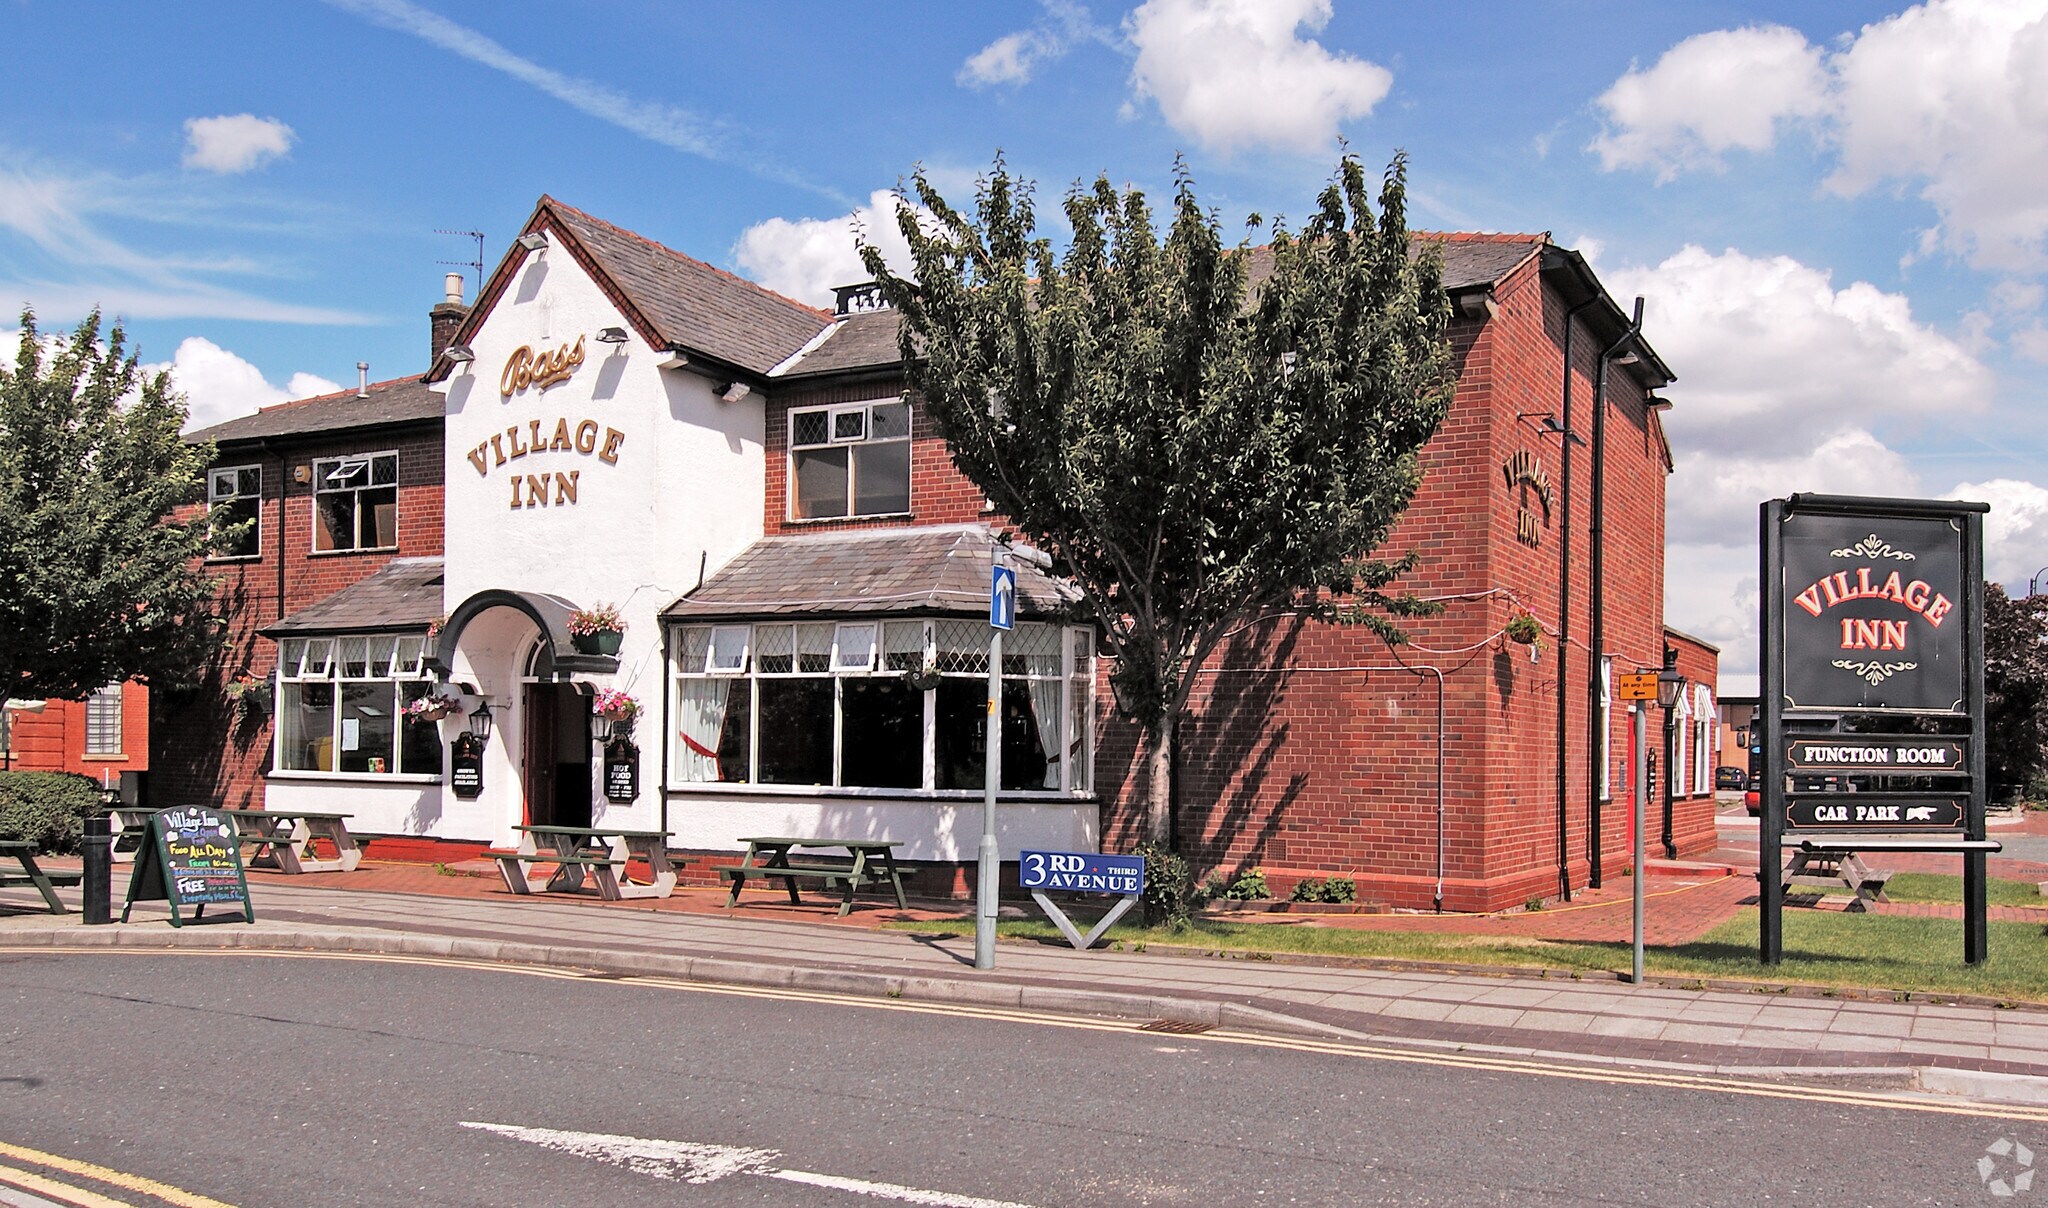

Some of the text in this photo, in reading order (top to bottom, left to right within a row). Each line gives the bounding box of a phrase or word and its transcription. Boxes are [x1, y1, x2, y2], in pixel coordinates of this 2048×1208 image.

[501, 334, 586, 396] Bass
[467, 417, 625, 477] VILLAGE
[510, 470, 580, 508] INN
[1794, 567, 1953, 628] VILLAGE
[1840, 618, 1909, 650] INN
[1804, 746, 1946, 764] FUNCTION ROOM
[610, 772, 632, 780] FOOD
[613, 764, 630, 772] HOT
[1814, 806, 1900, 821] CAR PARK
[1024, 853, 1086, 886] 3RD
[1107, 867, 1138, 876] THIRD
[177, 877, 206, 894] FREE
[1048, 873, 1138, 891] AVENUE
